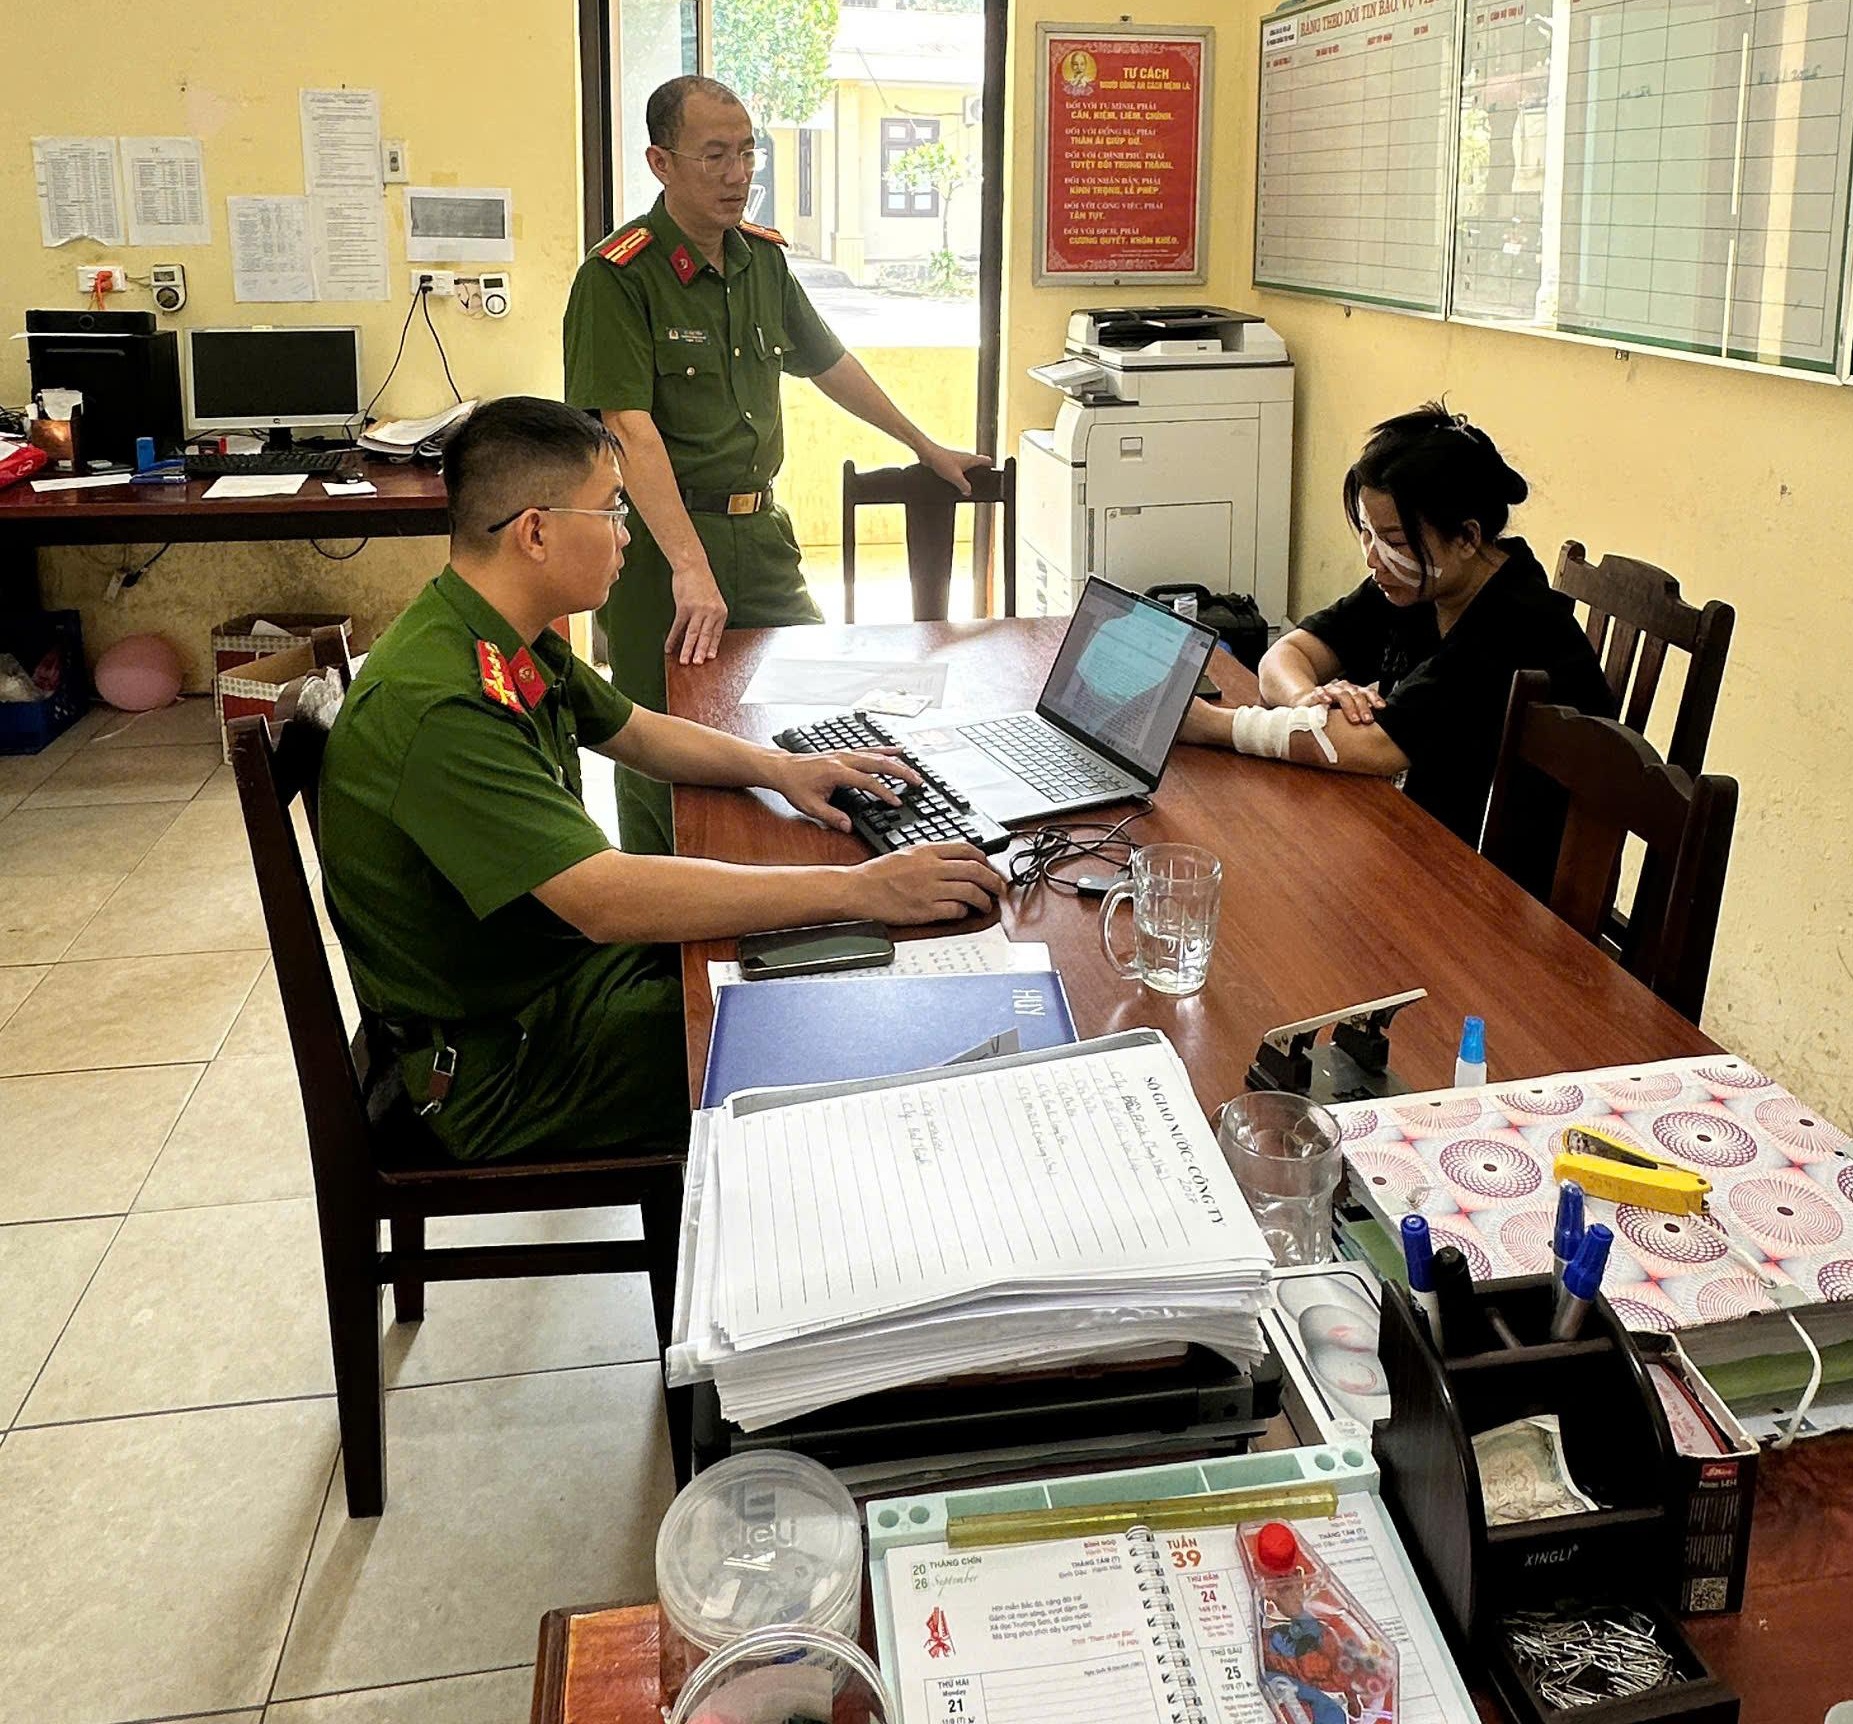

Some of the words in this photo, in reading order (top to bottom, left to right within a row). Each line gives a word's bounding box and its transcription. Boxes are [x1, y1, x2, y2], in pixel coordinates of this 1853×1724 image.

[1323, 12, 1343, 31] THEO
[1361, 7, 1376, 22] TIN
[1123, 67, 1138, 79] TƯ
[1140, 66, 1170, 79] CÁCH
[1012, 989, 1046, 1016] HUY
[1152, 1092, 1175, 1122] GIAO
[1187, 1165, 1216, 1204] CÔNG
[1208, 1208, 1227, 1227] TY
[1166, 1534, 1198, 1549] TUẦN
[912, 1564, 926, 1576] 20
[929, 1556, 960, 1569] THÁNG
[961, 1556, 982, 1566] CHÍN
[1171, 1550, 1202, 1568] 39
[914, 1578, 928, 1590] 26
[932, 1566, 979, 1597] September
[1201, 1590, 1217, 1603] 24
[1224, 1665, 1241, 1680] 25
[955, 1678, 970, 1687] HAI
[947, 1698, 964, 1713] 21
